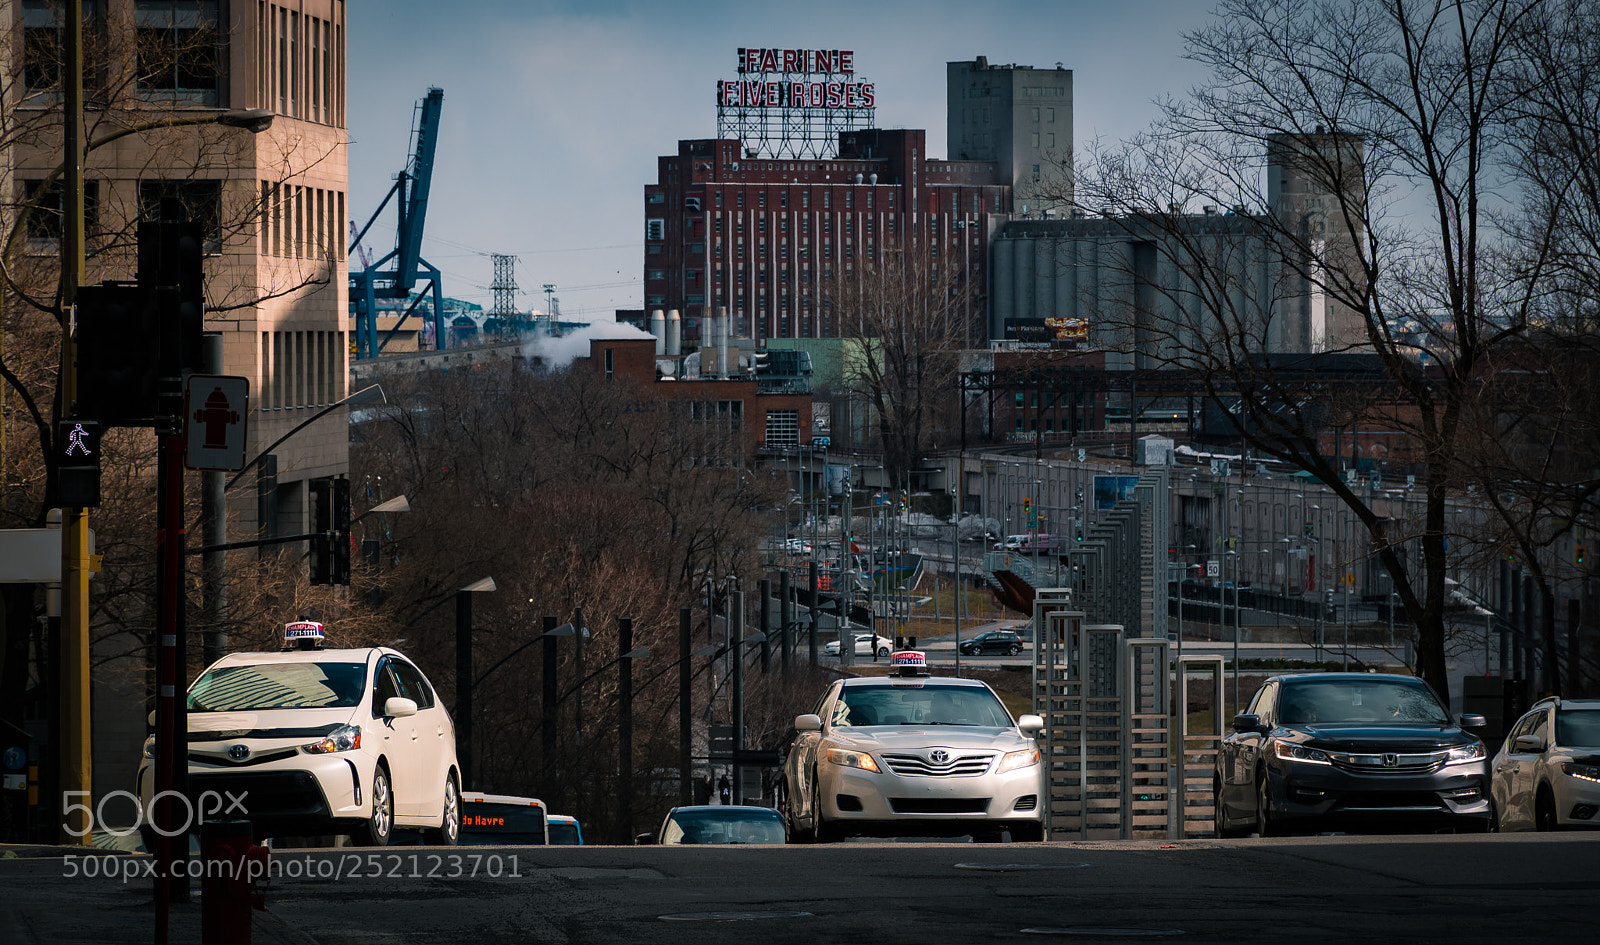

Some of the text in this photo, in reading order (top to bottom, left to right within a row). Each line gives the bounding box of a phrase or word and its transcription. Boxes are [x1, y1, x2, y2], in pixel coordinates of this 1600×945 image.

[745, 48, 855, 74] FARINE
[723, 81, 875, 108] FIVE ROSES
[1208, 566, 1218, 574] 50
[462, 815, 505, 826] du Havre
